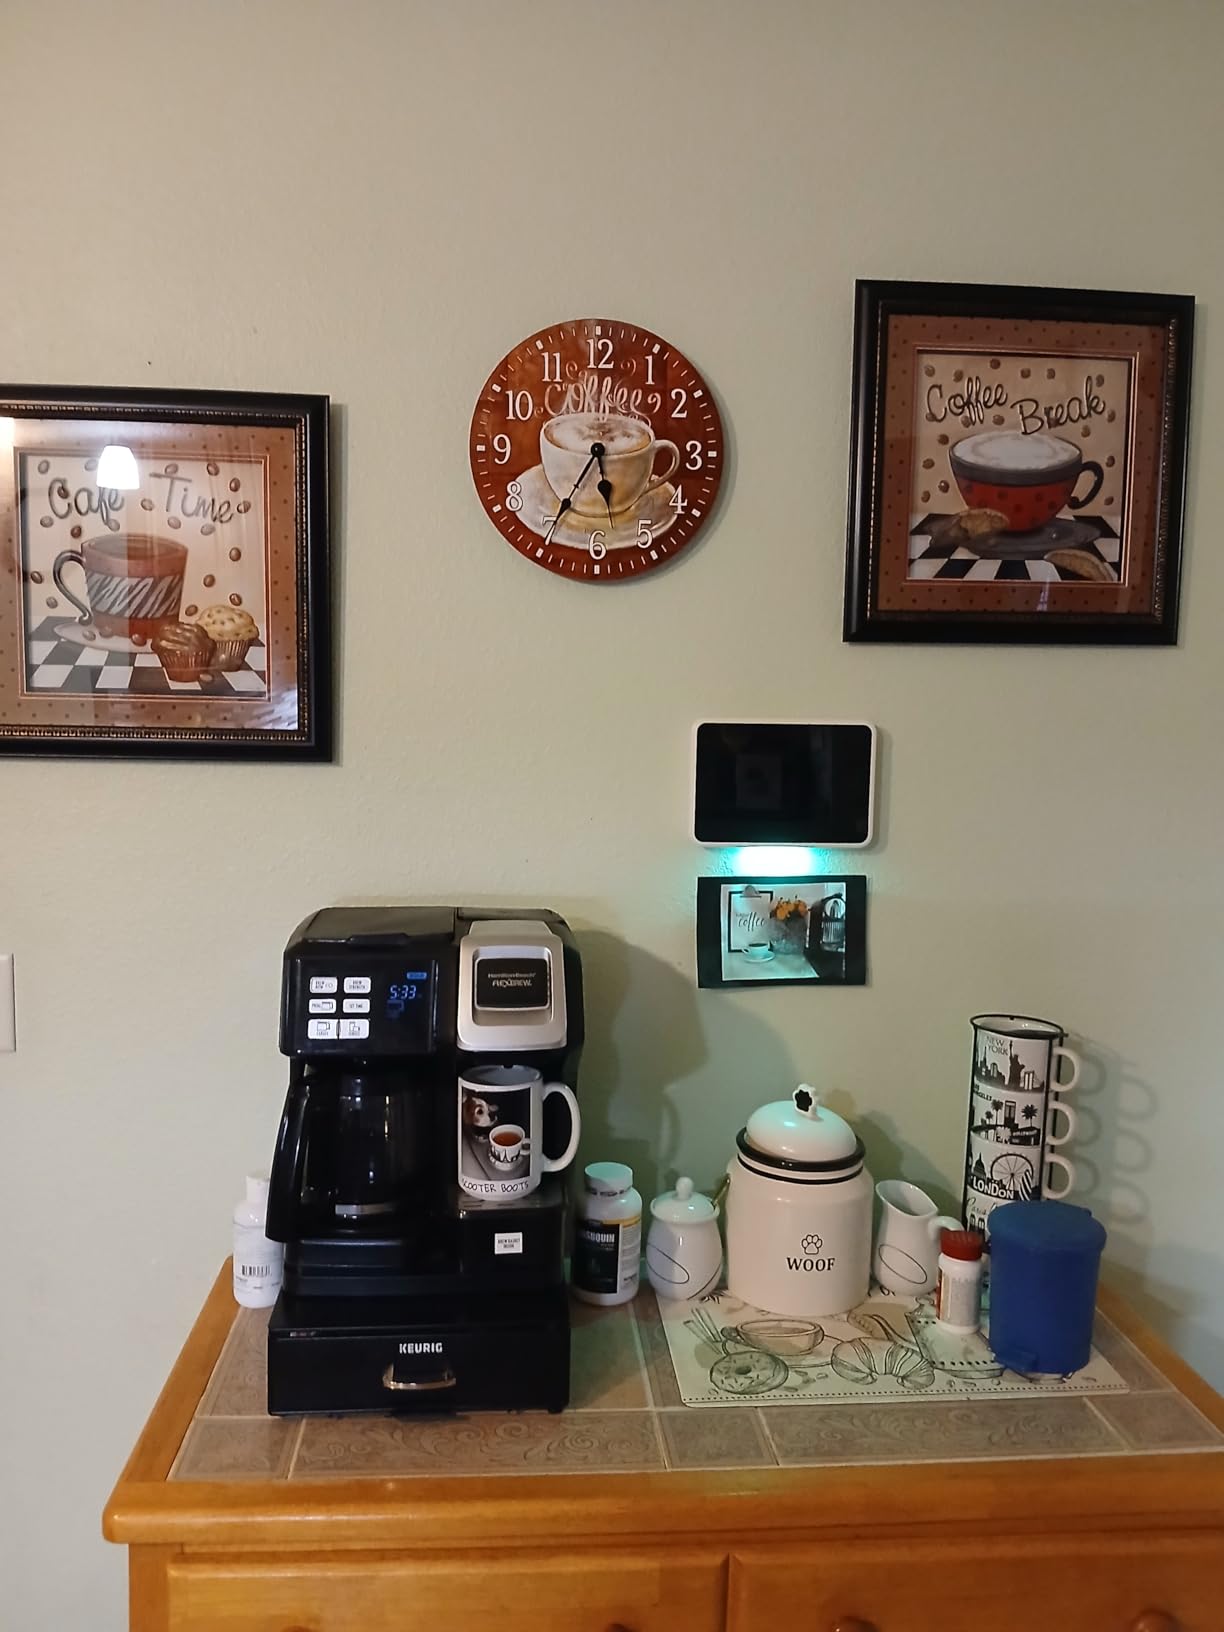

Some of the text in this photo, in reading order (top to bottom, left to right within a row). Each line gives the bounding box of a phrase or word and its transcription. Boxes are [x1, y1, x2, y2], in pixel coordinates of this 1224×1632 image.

[541, 352, 563, 382] 11
[586, 339, 614, 369] 12
[645, 355, 655, 385] 1
[505, 390, 534, 420] 10
[671, 388, 688, 418] 2
[926, 375, 1106, 435] Coffee Break
[493, 434, 511, 465] 9
[685, 440, 702, 470] 3
[150, 471, 235, 525] Time
[505, 481, 523, 511] 8
[669, 484, 687, 514] 4
[542, 516, 558, 544] 7
[636, 519, 652, 549] 5
[588, 531, 606, 560] 6
[389, 984, 417, 999] 5:33
[501, 1180, 529, 1192] BOOTS
[972, 1174, 1014, 1199] LONDON
[787, 1257, 836, 1272] WOOF
[399, 1342, 443, 1354] KEURIG
